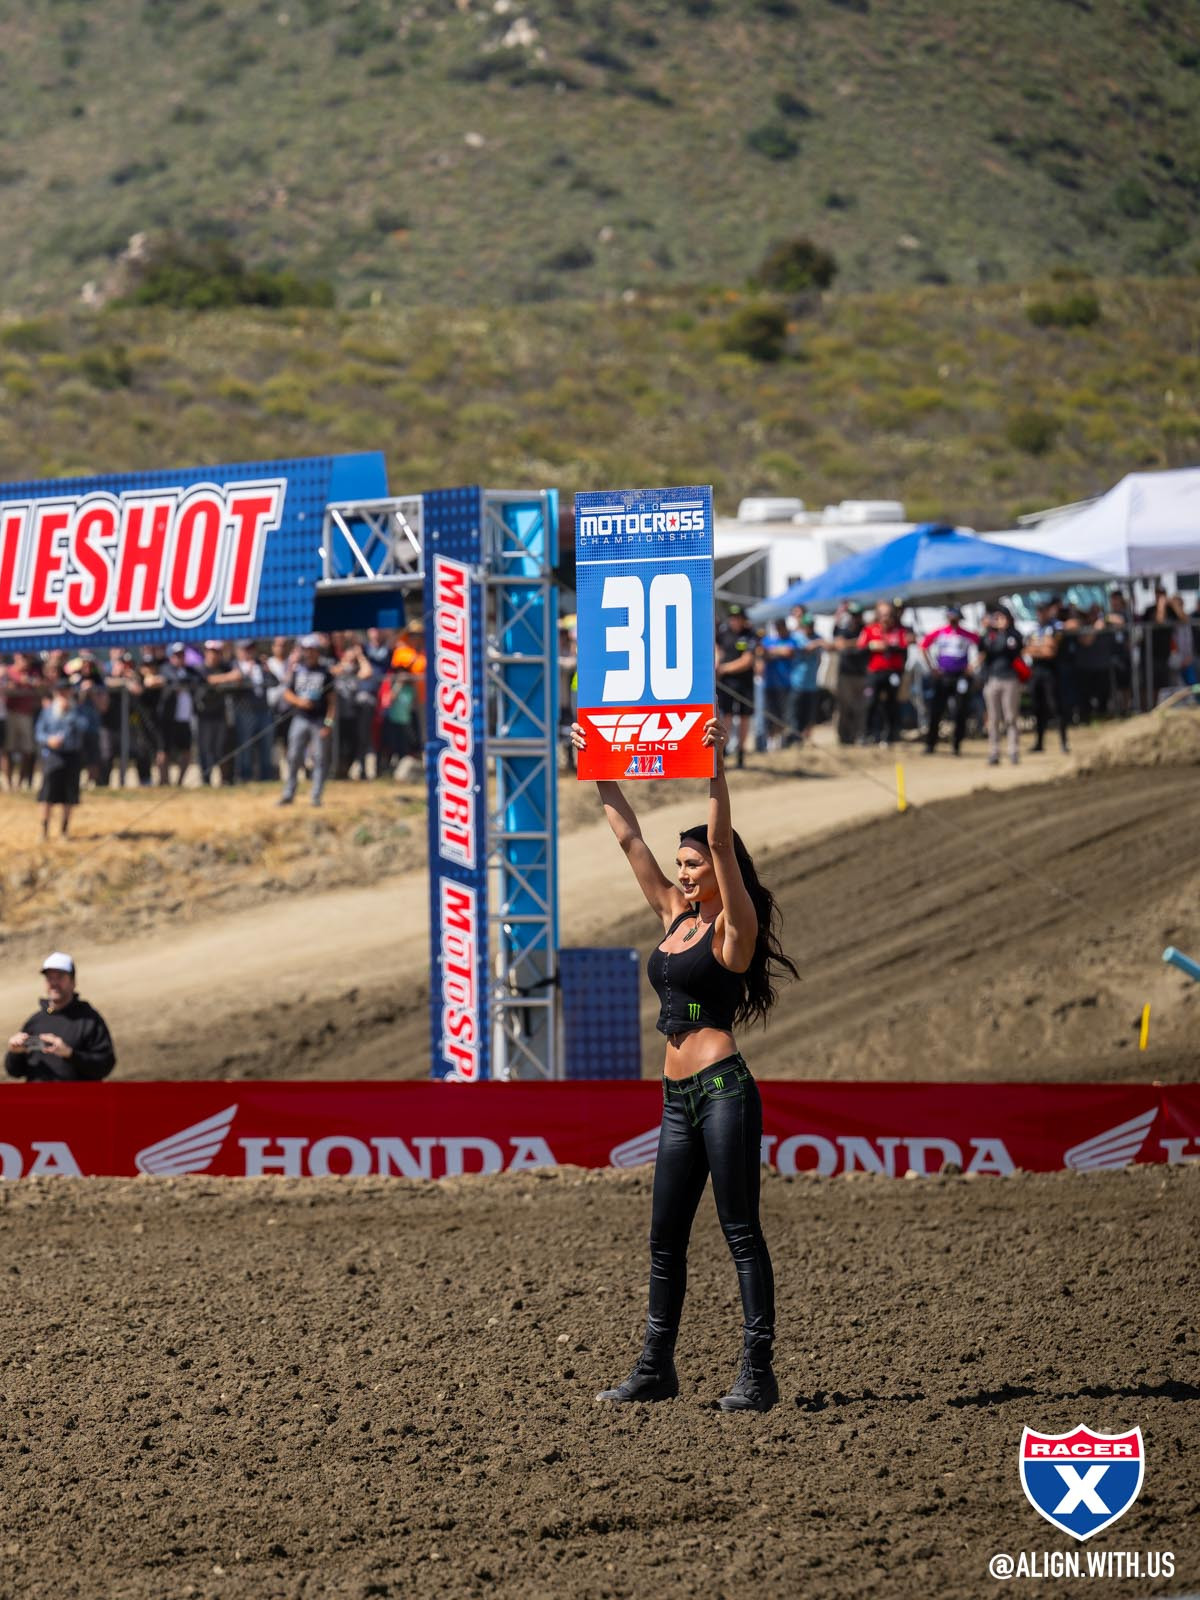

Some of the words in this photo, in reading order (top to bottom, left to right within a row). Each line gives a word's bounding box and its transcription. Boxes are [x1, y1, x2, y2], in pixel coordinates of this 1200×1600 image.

[626, 504, 659, 512] PRO
[580, 510, 705, 537] MOTOCROSS
[580, 531, 705, 546] CHAMPIONSHIP
[601, 573, 693, 702] 30
[586, 711, 704, 743] FLY
[611, 742, 678, 752] RACING
[624, 754, 665, 777] AMA
[238, 1135, 559, 1179] HONDA
[761, 1134, 1016, 1178] ONDA
